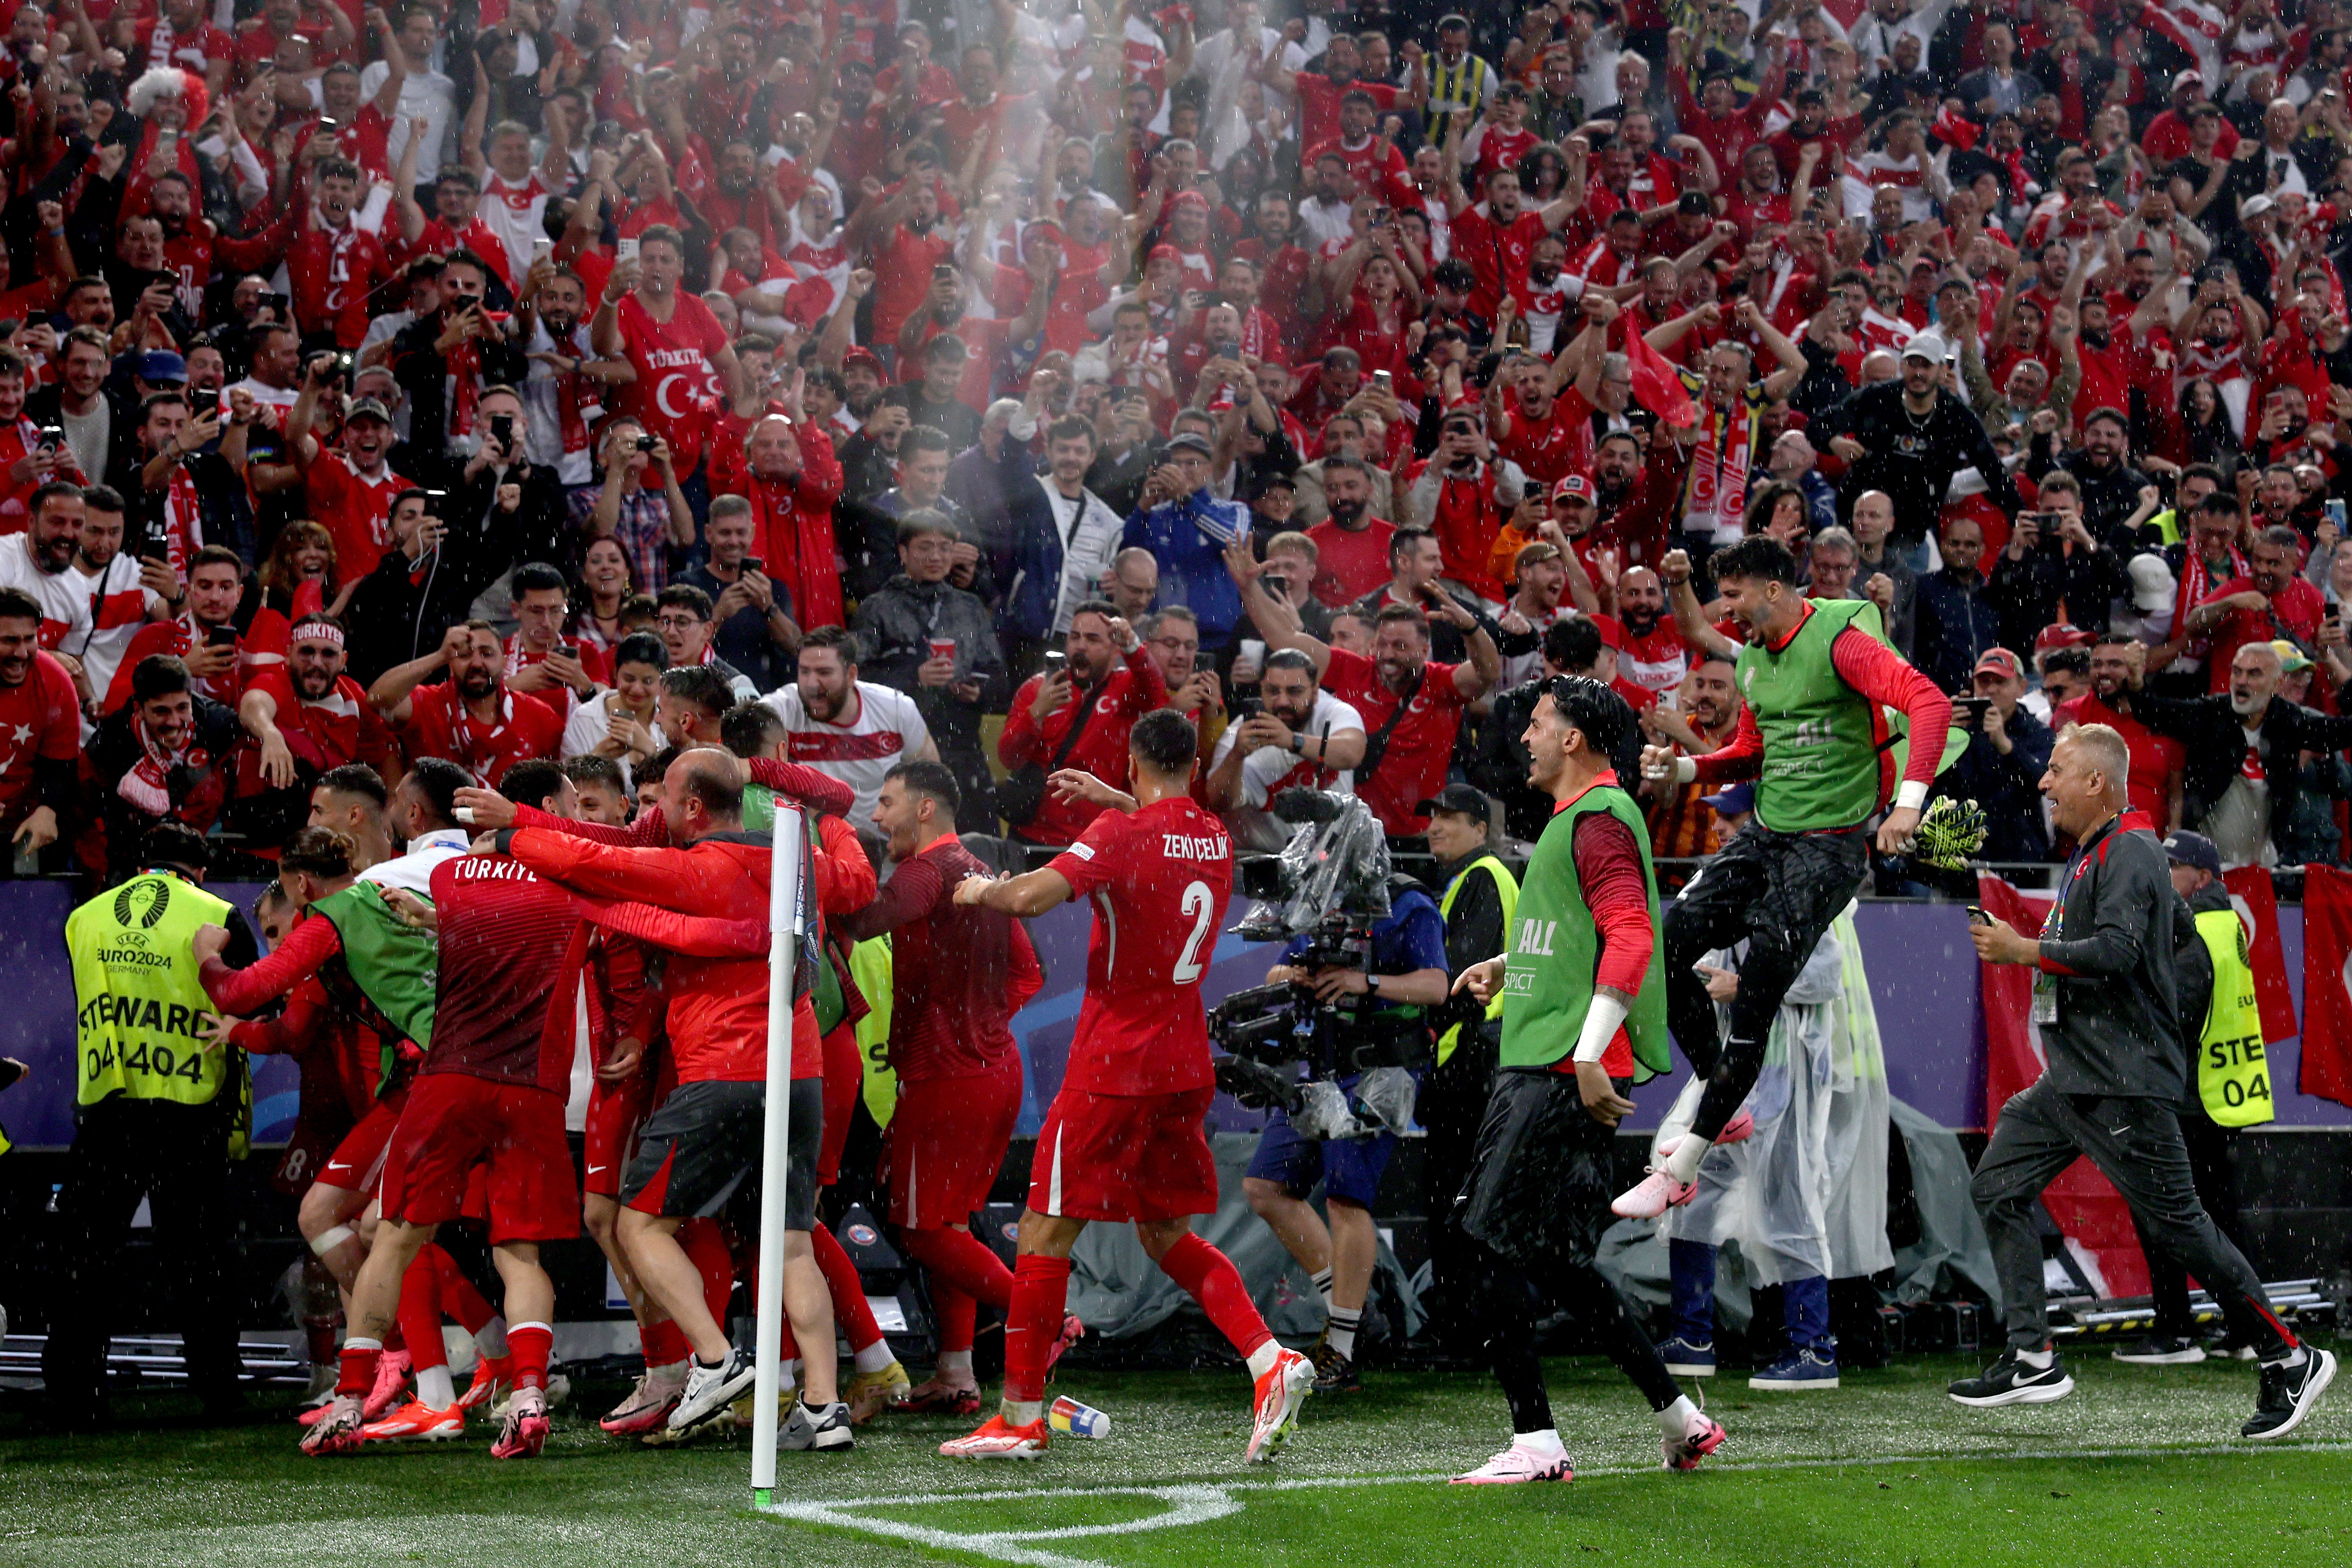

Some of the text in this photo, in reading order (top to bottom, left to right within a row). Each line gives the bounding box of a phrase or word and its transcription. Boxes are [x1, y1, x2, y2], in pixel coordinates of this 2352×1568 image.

[1162, 832, 1228, 863] ZEKİ ÇELİK
[1172, 880, 1212, 985] 2
[107, 965, 151, 976] GERMANY
[79, 992, 215, 1041] STEWARD
